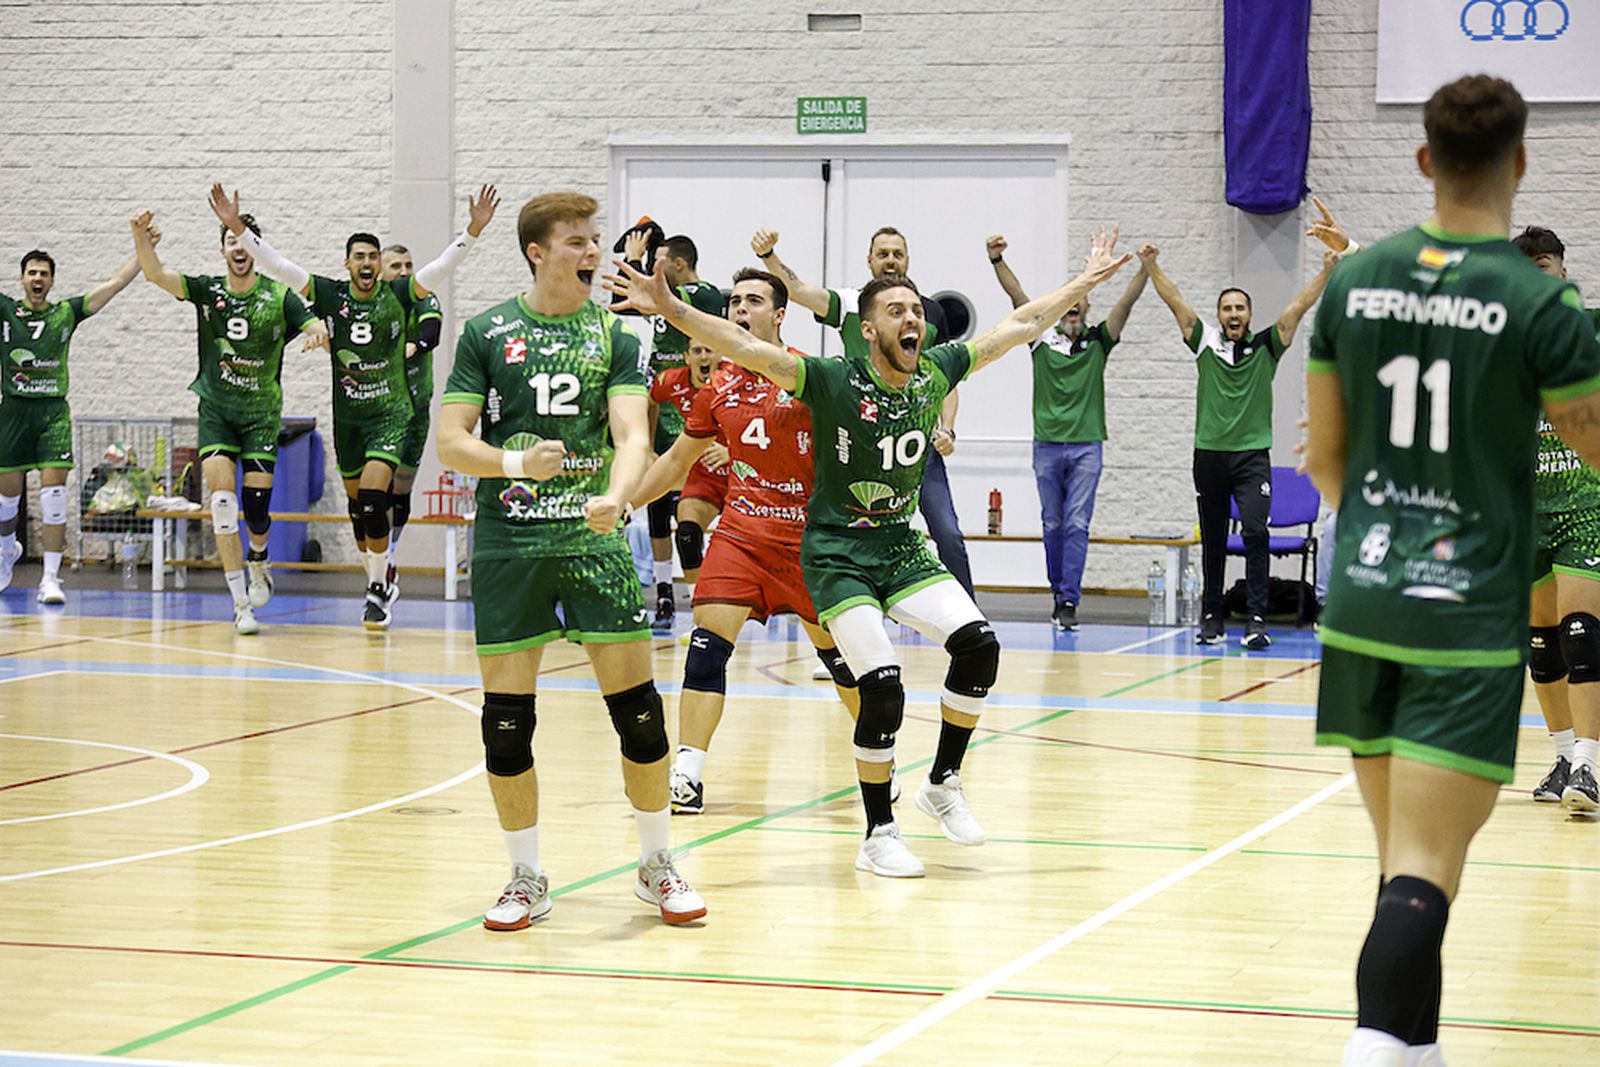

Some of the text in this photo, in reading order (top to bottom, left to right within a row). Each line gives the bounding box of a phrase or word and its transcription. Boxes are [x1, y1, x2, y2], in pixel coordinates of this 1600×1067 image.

[803, 100, 862, 114] SALIDA DE
[801, 116, 864, 130] EMERGENCIA
[1346, 288, 1508, 335] FERNANDO
[27, 320, 46, 340] 7
[227, 317, 249, 341] 9
[350, 321, 373, 345] 8
[655, 314, 667, 333] 3
[528, 372, 581, 416] 12
[1376, 354, 1451, 453] 11
[740, 417, 771, 450] 4
[876, 429, 927, 471] 10
[1538, 451, 1564, 461] OSTA
[561, 452, 604, 474] nicaja
[1536, 459, 1582, 473] MERÍA
